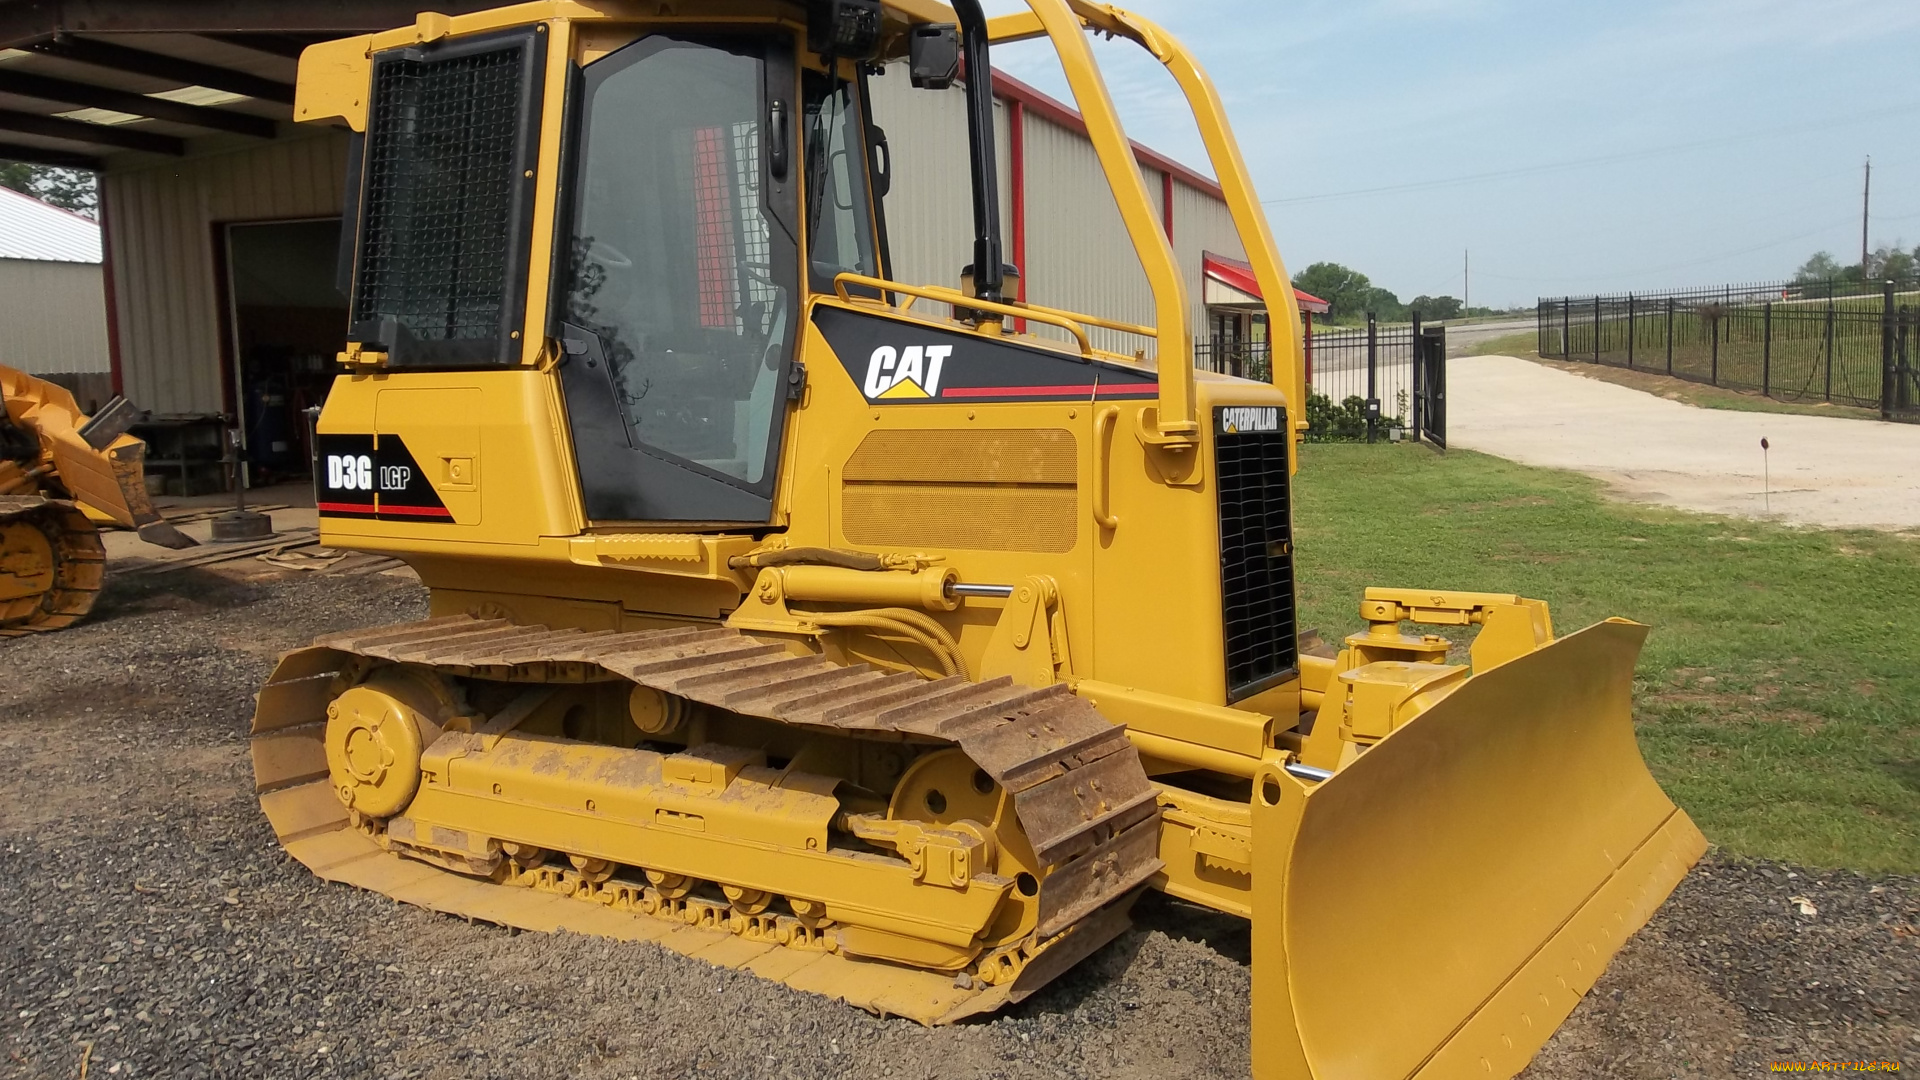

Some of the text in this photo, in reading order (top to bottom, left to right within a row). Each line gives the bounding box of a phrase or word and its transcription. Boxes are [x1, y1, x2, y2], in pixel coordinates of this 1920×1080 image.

[864, 345, 953, 399] CAT
[1223, 407, 1277, 432] CATERPILLAR
[327, 454, 411, 490] D3G LGP
